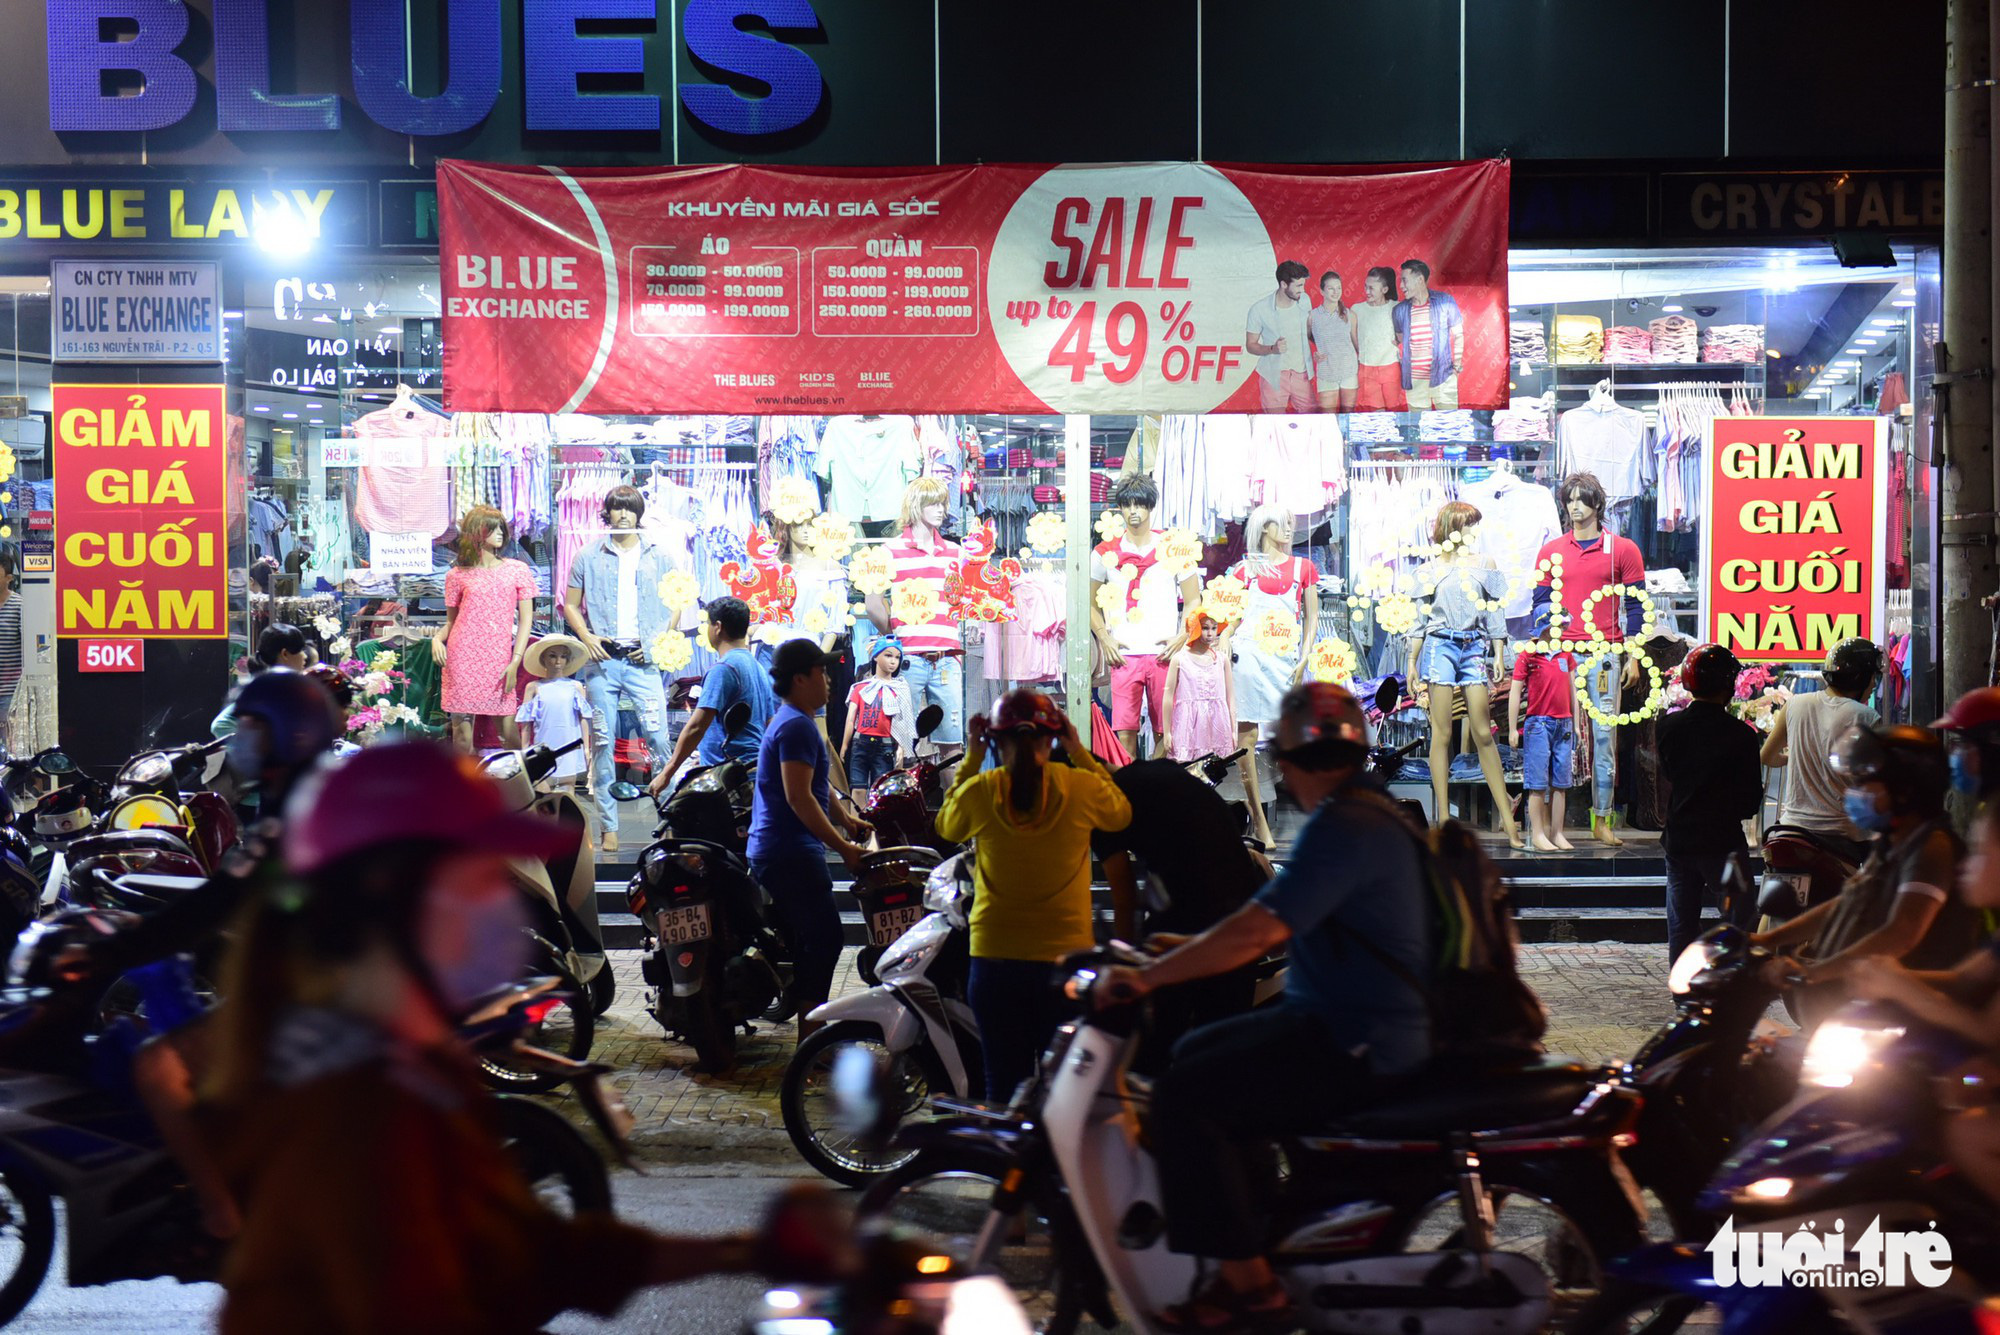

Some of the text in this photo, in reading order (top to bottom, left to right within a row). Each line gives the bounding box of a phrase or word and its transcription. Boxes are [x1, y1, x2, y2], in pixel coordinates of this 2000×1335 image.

[46, 0, 823, 135] BLUES
[783, 199, 830, 216] MÃI
[838, 199, 880, 216] GIÁ
[888, 196, 940, 216] SỐC
[700, 233, 730, 255] ÁO
[866, 232, 922, 259] QUẦN
[1043, 196, 1204, 290] SALE
[74, 270, 197, 286] CN CTY TNHH MTV
[457, 255, 578, 290] BLUE
[62, 296, 211, 333] BLUE EXCHANGE
[447, 297, 590, 319] EXCHANGE
[1006, 295, 1074, 327] up to
[62, 342, 100, 353] 161-163
[1047, 300, 1149, 384] 49
[799, 372, 835, 382] KID'S
[860, 372, 891, 382] BLUE
[1161, 345, 1242, 383] OFF
[714, 374, 776, 387] THE BLUES
[755, 395, 845, 405] www.theblues.vn
[59, 394, 211, 448] GIẢM
[1720, 428, 1862, 479] GIẢM
[86, 461, 195, 505] GIÁ
[1739, 491, 1843, 534] GIÁ
[63, 518, 214, 567] CUỐI
[28, 557, 49, 566] VISA
[1719, 547, 1861, 593] CUỐI
[63, 580, 214, 630] NĂM
[1717, 605, 1862, 652] NĂM
[86, 646, 136, 667] 50K
[665, 906, 701, 927] 36-B4
[880, 907, 916, 928] 81-B2
